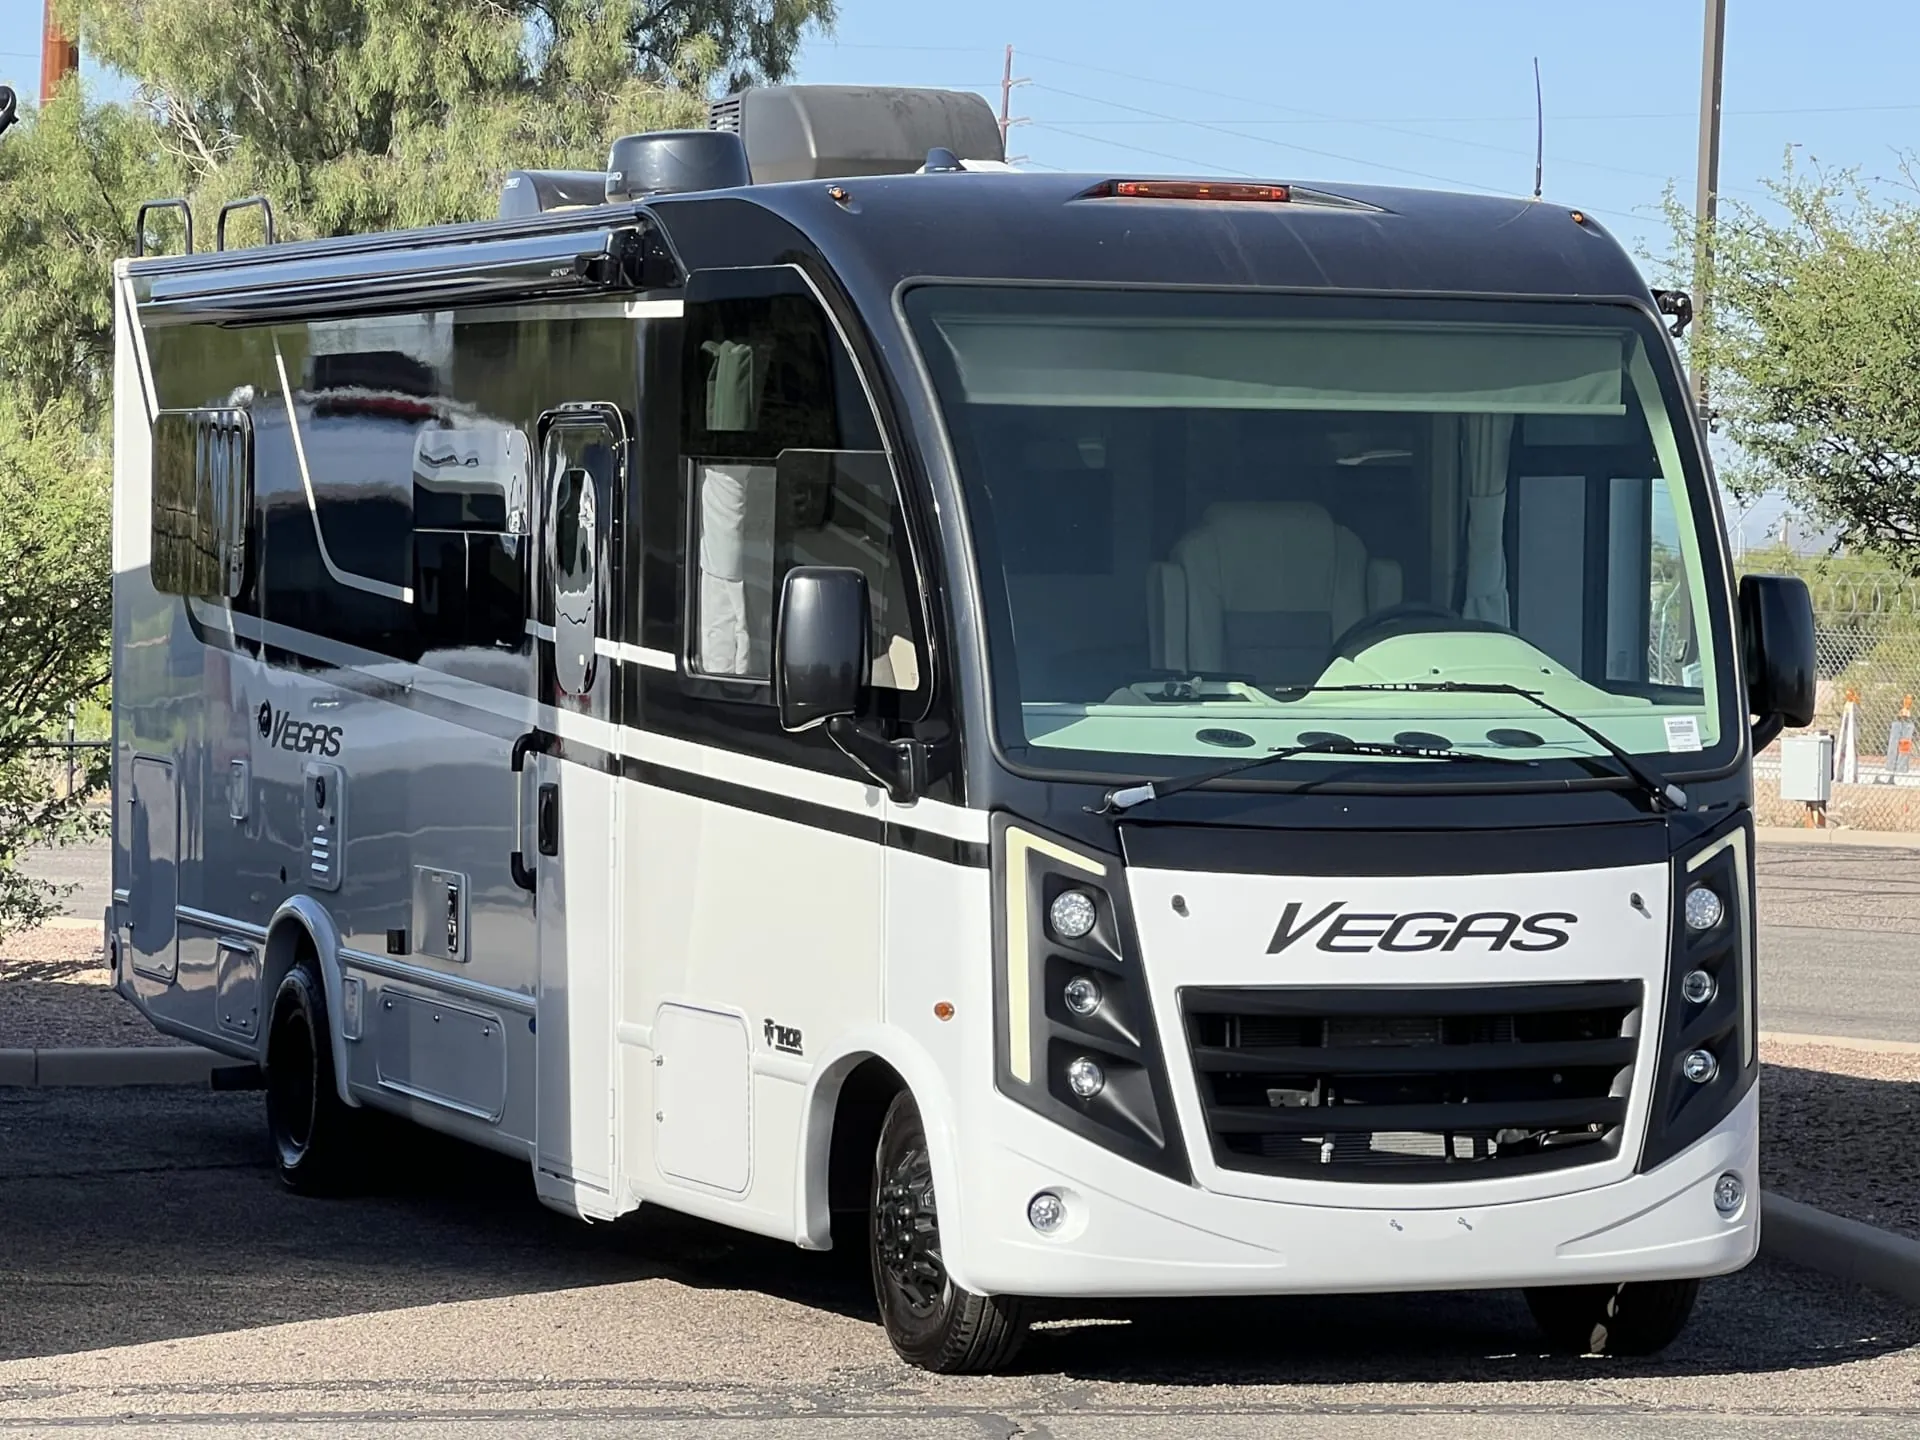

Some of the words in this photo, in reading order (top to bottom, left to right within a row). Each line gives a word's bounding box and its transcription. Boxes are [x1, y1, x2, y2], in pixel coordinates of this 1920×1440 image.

[271, 709, 343, 757] VEGAS
[1265, 901, 1578, 954] VEGAS
[775, 1024, 803, 1050] THOR
